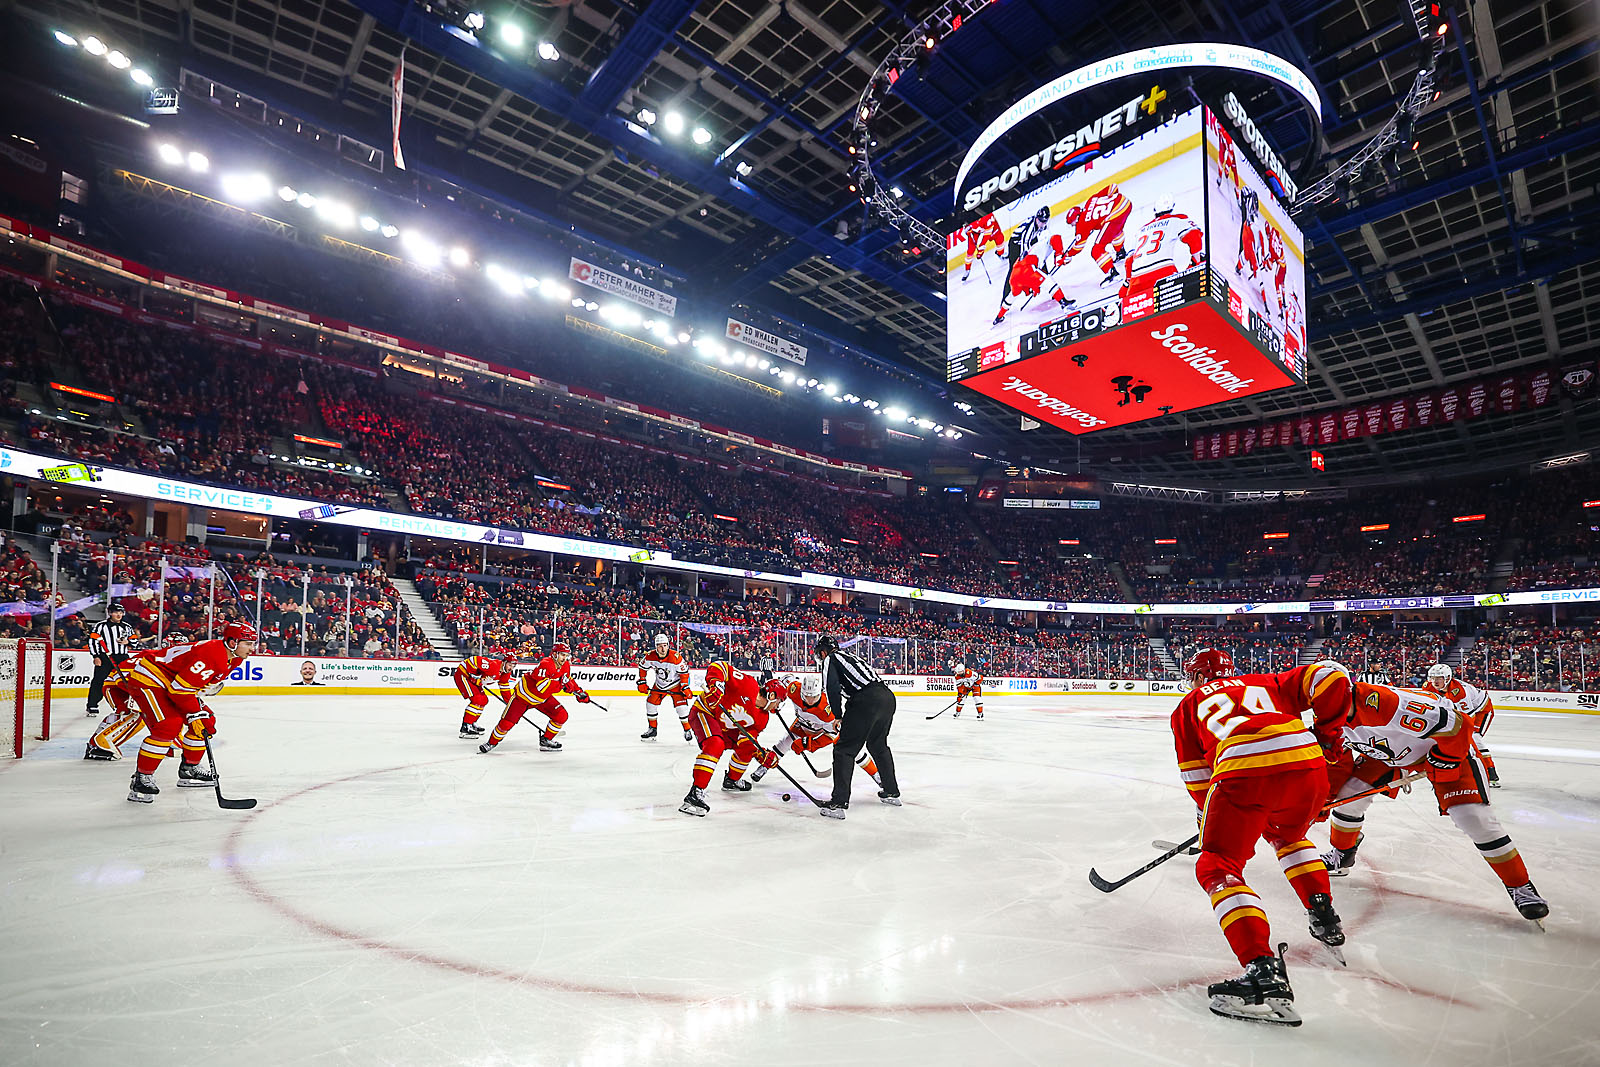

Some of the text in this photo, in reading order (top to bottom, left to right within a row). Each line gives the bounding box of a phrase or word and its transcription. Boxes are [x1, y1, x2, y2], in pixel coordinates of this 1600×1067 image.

[1004, 98, 1036, 126] LOUD
[1077, 60, 1124, 85] CLEAR
[1223, 92, 1298, 202] SPORTSNET
[1133, 230, 1166, 260] 23
[593, 269, 622, 287] PETER
[625, 281, 655, 300] MAHER
[745, 326, 752, 336] ED
[755, 330, 778, 346] WHALEN
[1027, 315, 1099, 350] 1 17:16 0
[1572, 375, 1584, 384] 20
[158, 482, 254, 508] SERVICE
[379, 516, 453, 535] RENTALS
[563, 542, 606, 556] SALES
[1540, 590, 1600, 600] SERVIC
[190, 661, 214, 680] 94
[538, 669, 546, 677] 11
[571, 672, 636, 681] play alberta
[1200, 680, 1245, 696] BEAN
[1577, 694, 1599, 704] SN
[1197, 686, 1283, 741] 24
[1400, 701, 1435, 732] 64
